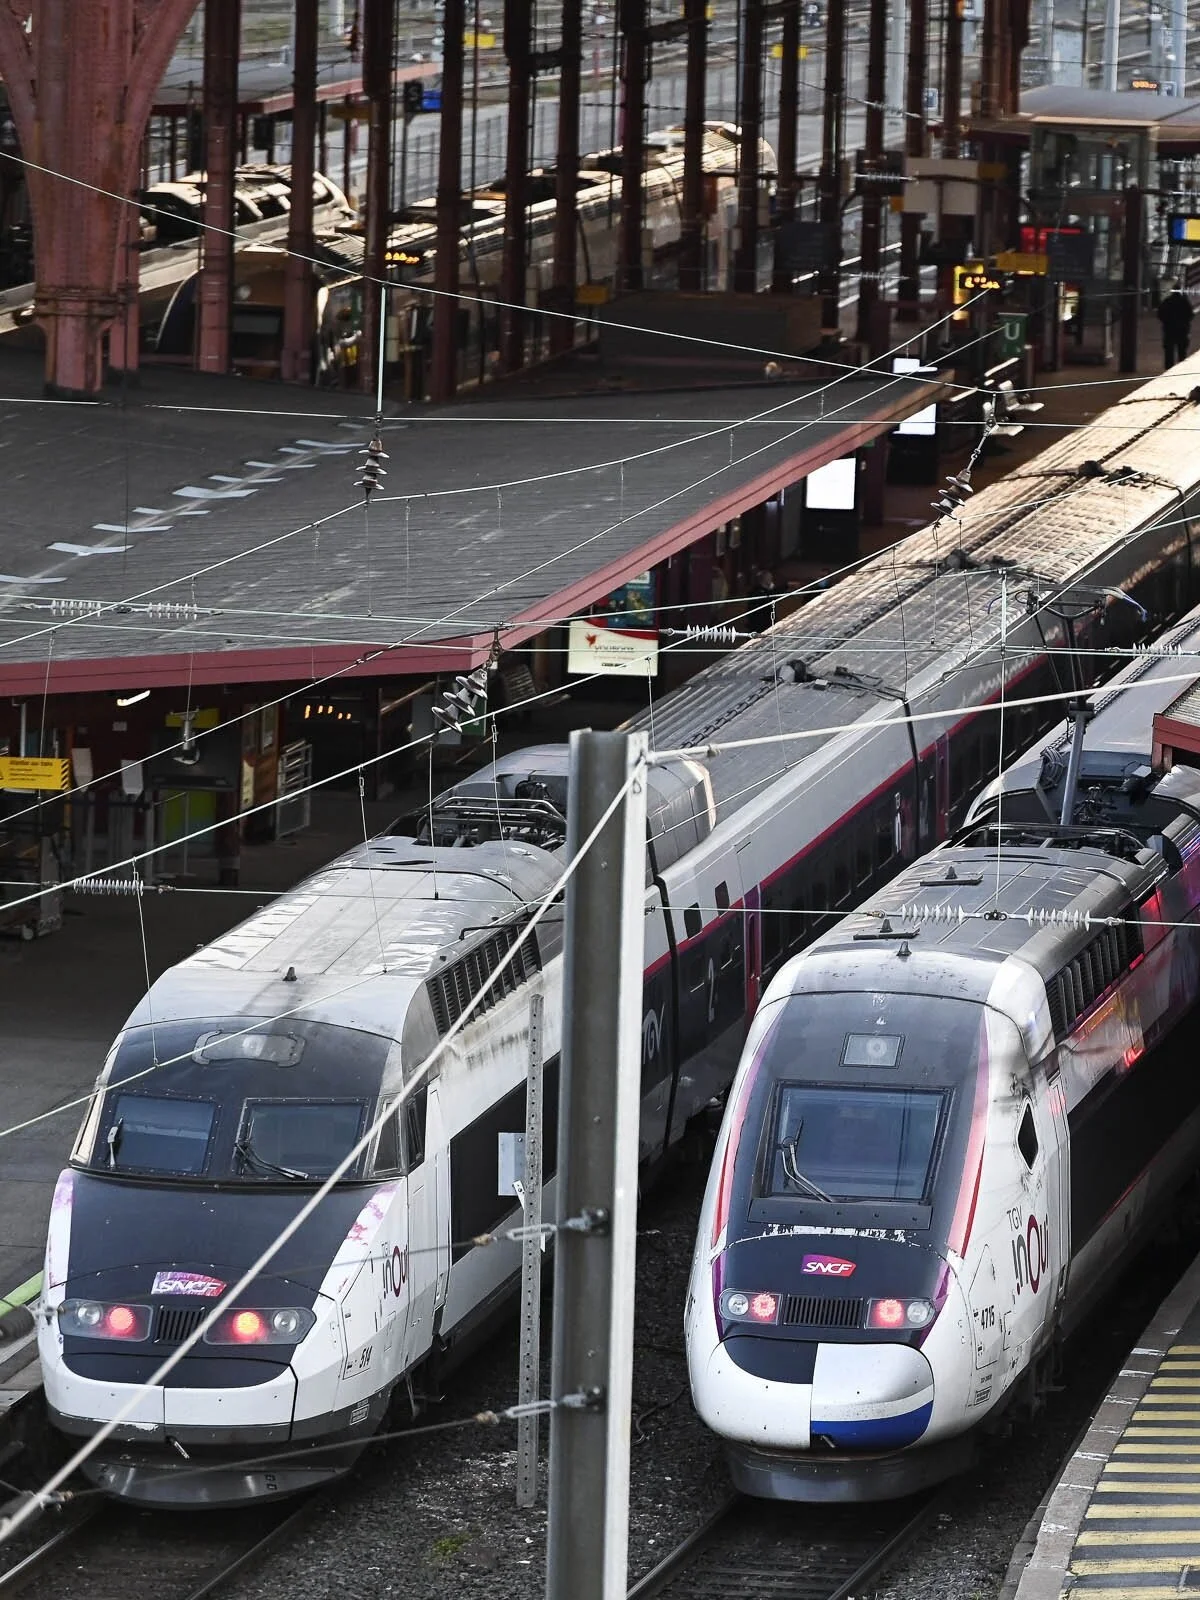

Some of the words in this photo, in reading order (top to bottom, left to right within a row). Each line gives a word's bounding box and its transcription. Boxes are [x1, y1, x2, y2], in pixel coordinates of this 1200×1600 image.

[1006, 1205, 1023, 1232] TGV
[802, 1261, 853, 1274] SNCF
[156, 1280, 222, 1293] SNCF
[980, 1304, 995, 1330] 4715
